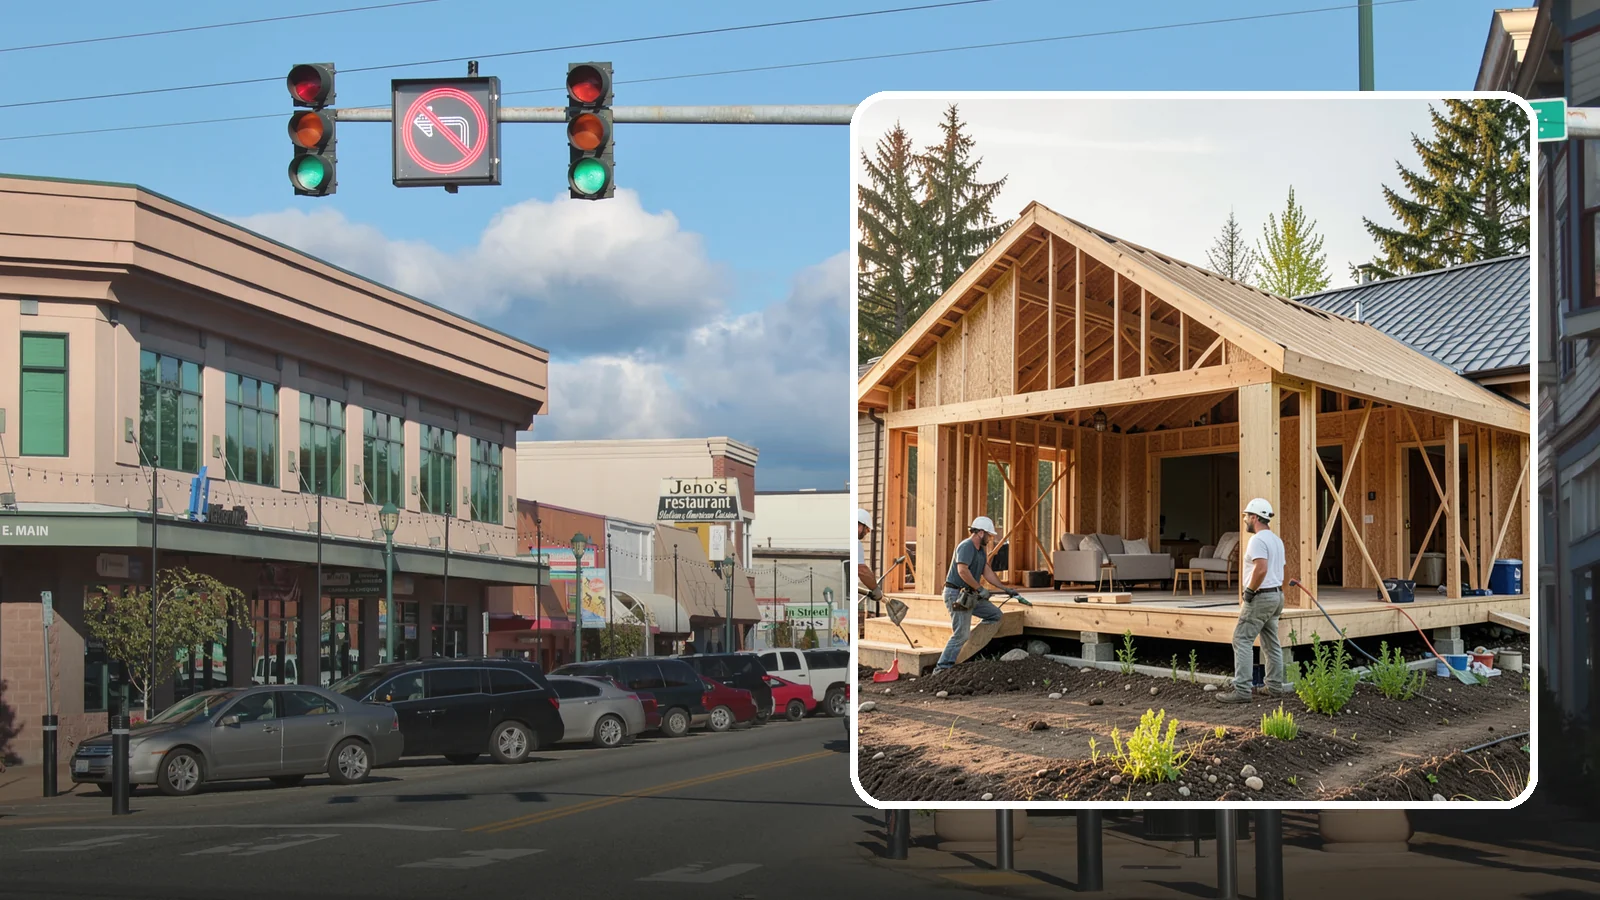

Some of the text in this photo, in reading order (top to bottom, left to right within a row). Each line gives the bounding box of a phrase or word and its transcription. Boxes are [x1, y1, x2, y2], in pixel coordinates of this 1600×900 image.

[670, 480, 727, 494] Jeno's
[665, 496, 731, 509] restaurant
[658, 510, 681, 519] Italian
[686, 509, 714, 519] American
[715, 509, 737, 519] Cuisine
[2, 525, 49, 536] E. MAIN
[797, 608, 828, 616] Street
[790, 619, 824, 627] lass
